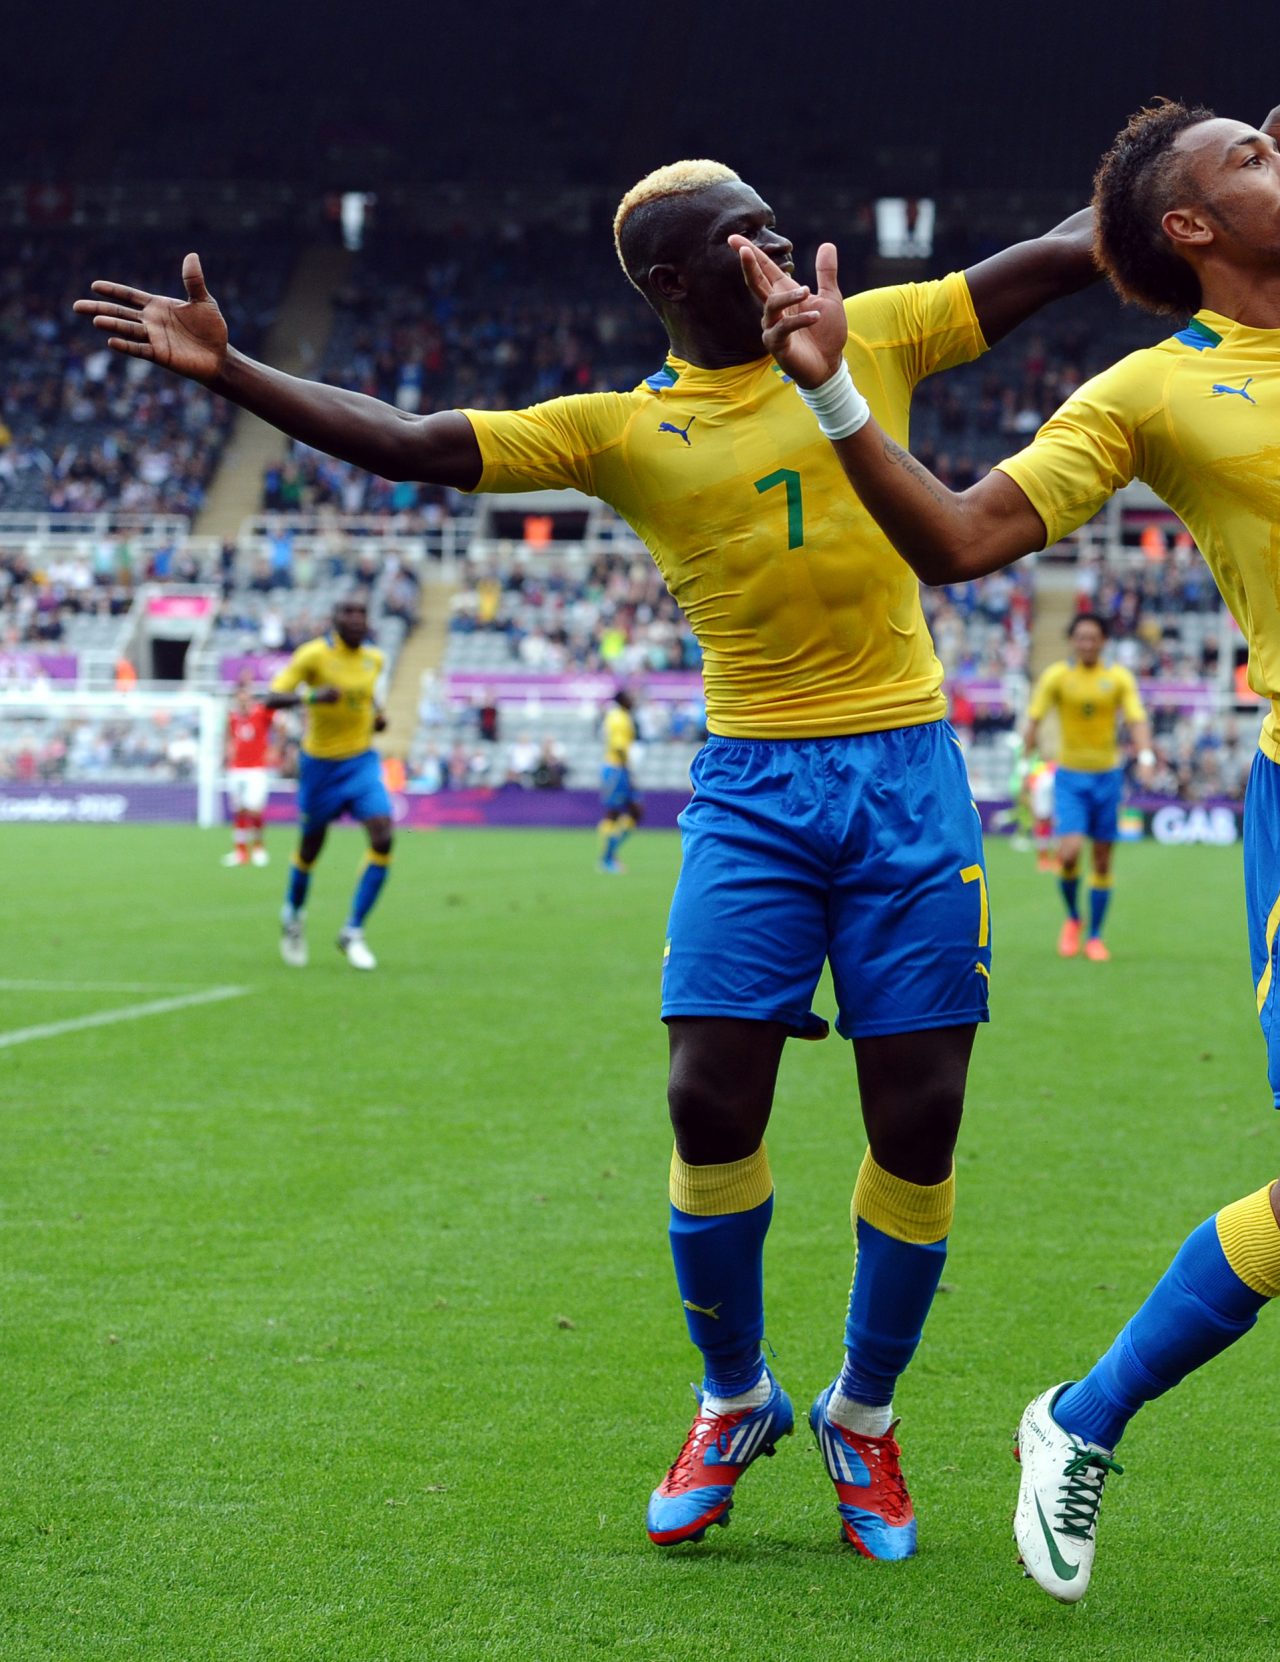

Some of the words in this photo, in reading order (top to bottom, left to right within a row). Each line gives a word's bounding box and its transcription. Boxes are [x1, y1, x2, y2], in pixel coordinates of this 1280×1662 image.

[753, 468, 804, 550] 7
[1152, 806, 1237, 845] GAB
[960, 864, 989, 947] 7
